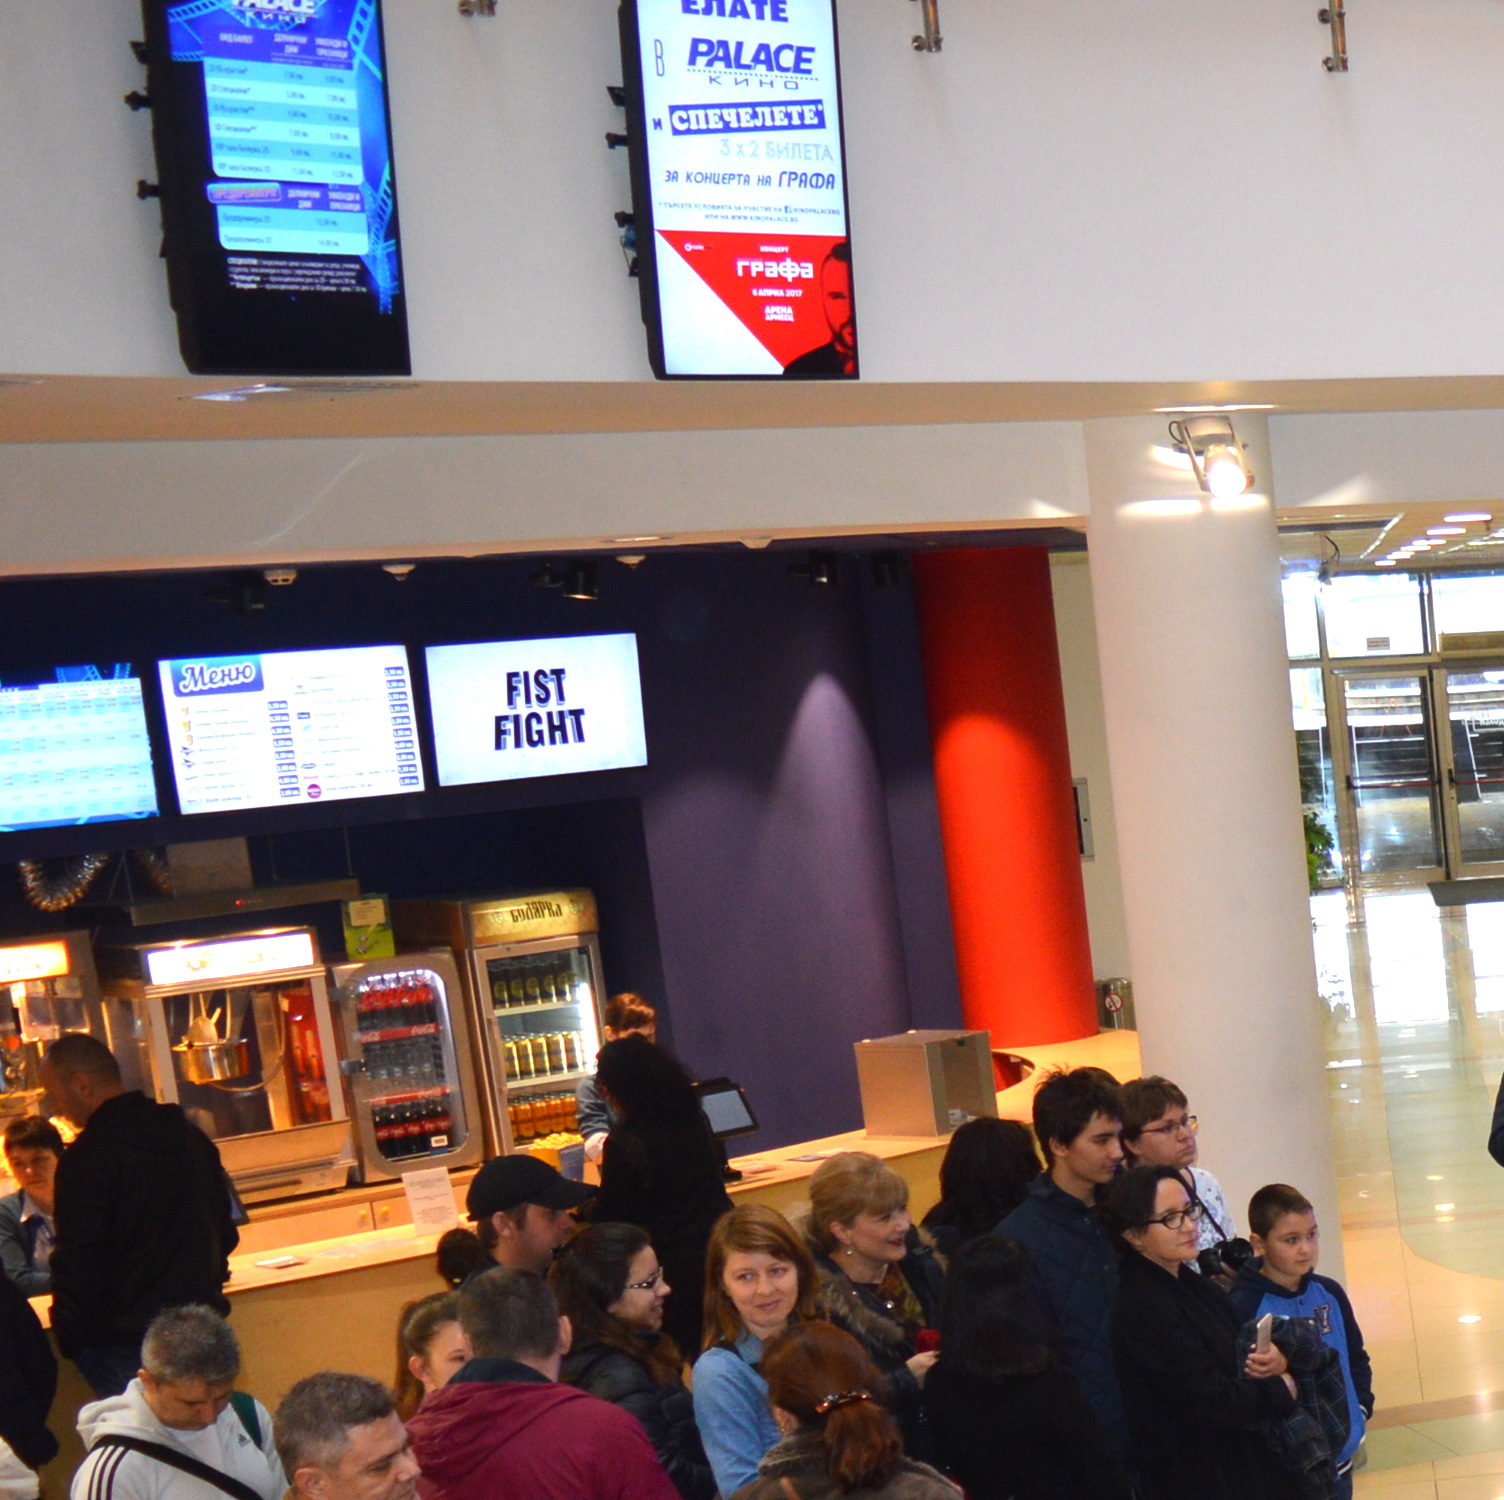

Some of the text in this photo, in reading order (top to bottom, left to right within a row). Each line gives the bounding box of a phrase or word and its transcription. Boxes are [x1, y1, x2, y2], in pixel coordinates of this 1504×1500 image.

[687, 37, 816, 75] PALACE
[709, 75, 799, 90] КИНО
[749, 141, 759, 158] 2
[766, 141, 834, 162] БИЛЕТА
[664, 170, 679, 183] ЗА
[685, 171, 750, 186] КОНЦЕРТА
[778, 171, 835, 190] ГРАФА
[764, 305, 793, 315] АРЕНА
[181, 663, 254, 693] Меню
[506, 668, 566, 709] FIST
[494, 708, 586, 751] FIGHT
